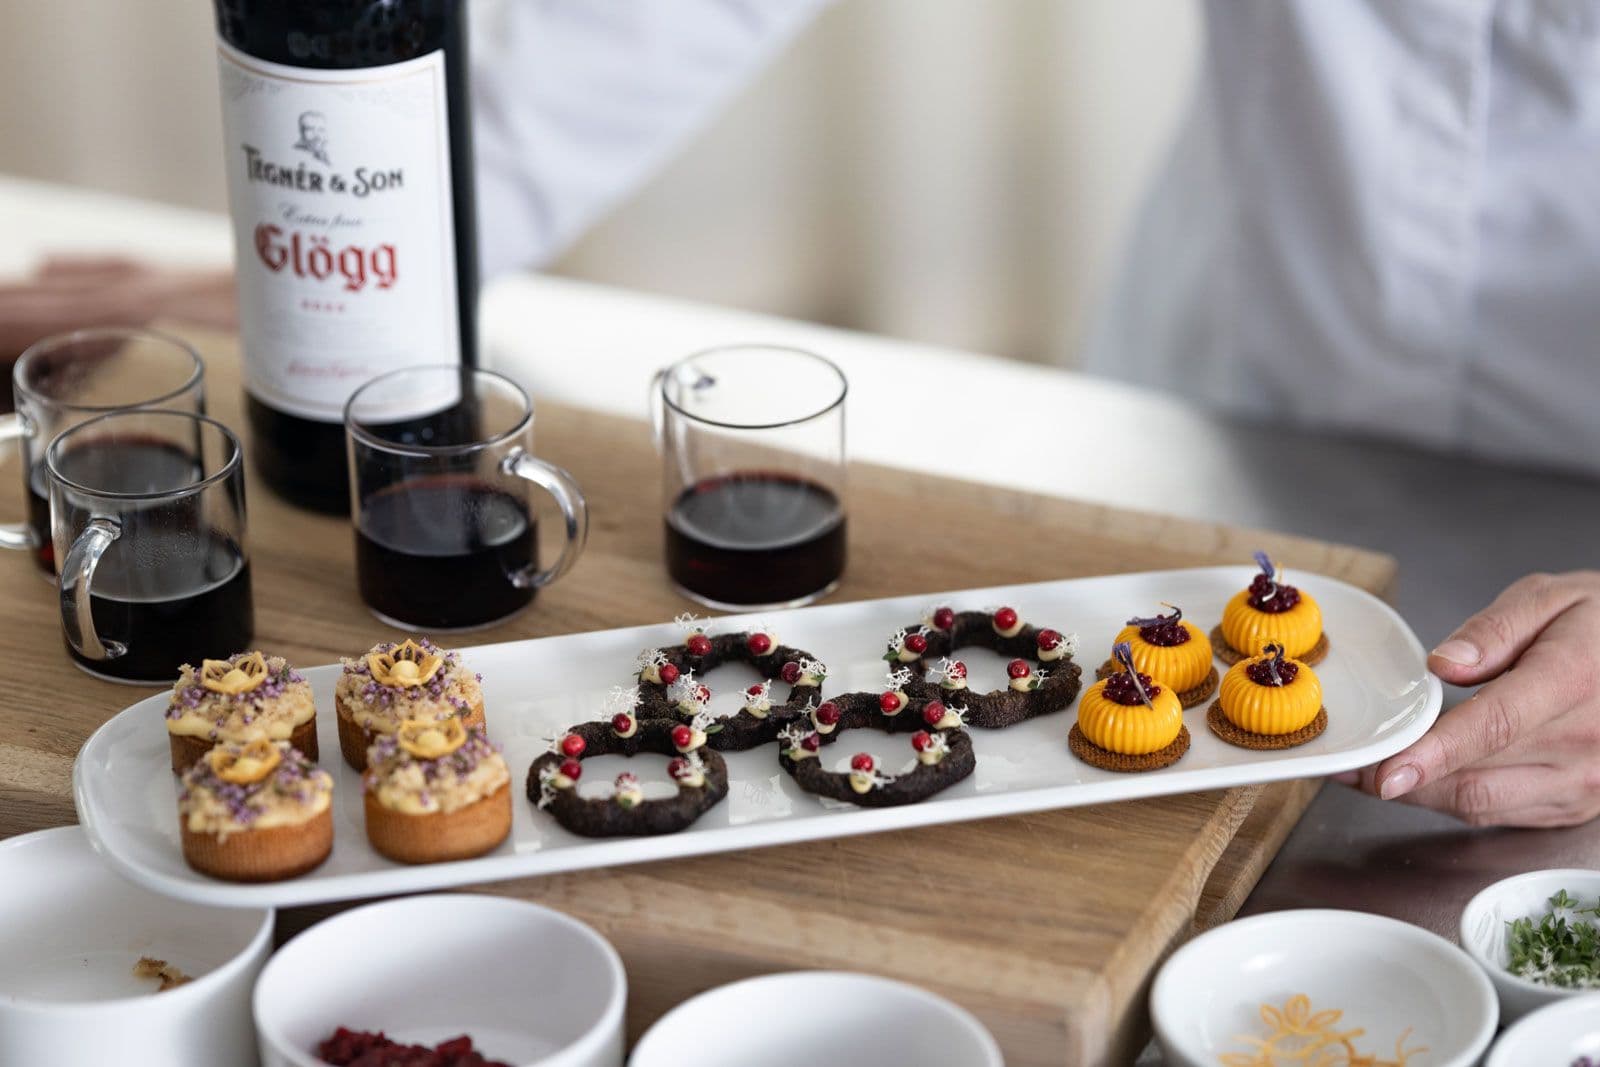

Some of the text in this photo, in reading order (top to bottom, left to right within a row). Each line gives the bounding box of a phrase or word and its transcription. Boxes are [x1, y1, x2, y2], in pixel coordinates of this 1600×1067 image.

[329, 173, 347, 193] &
[352, 167, 405, 198] SON
[254, 221, 398, 292] Glögg
